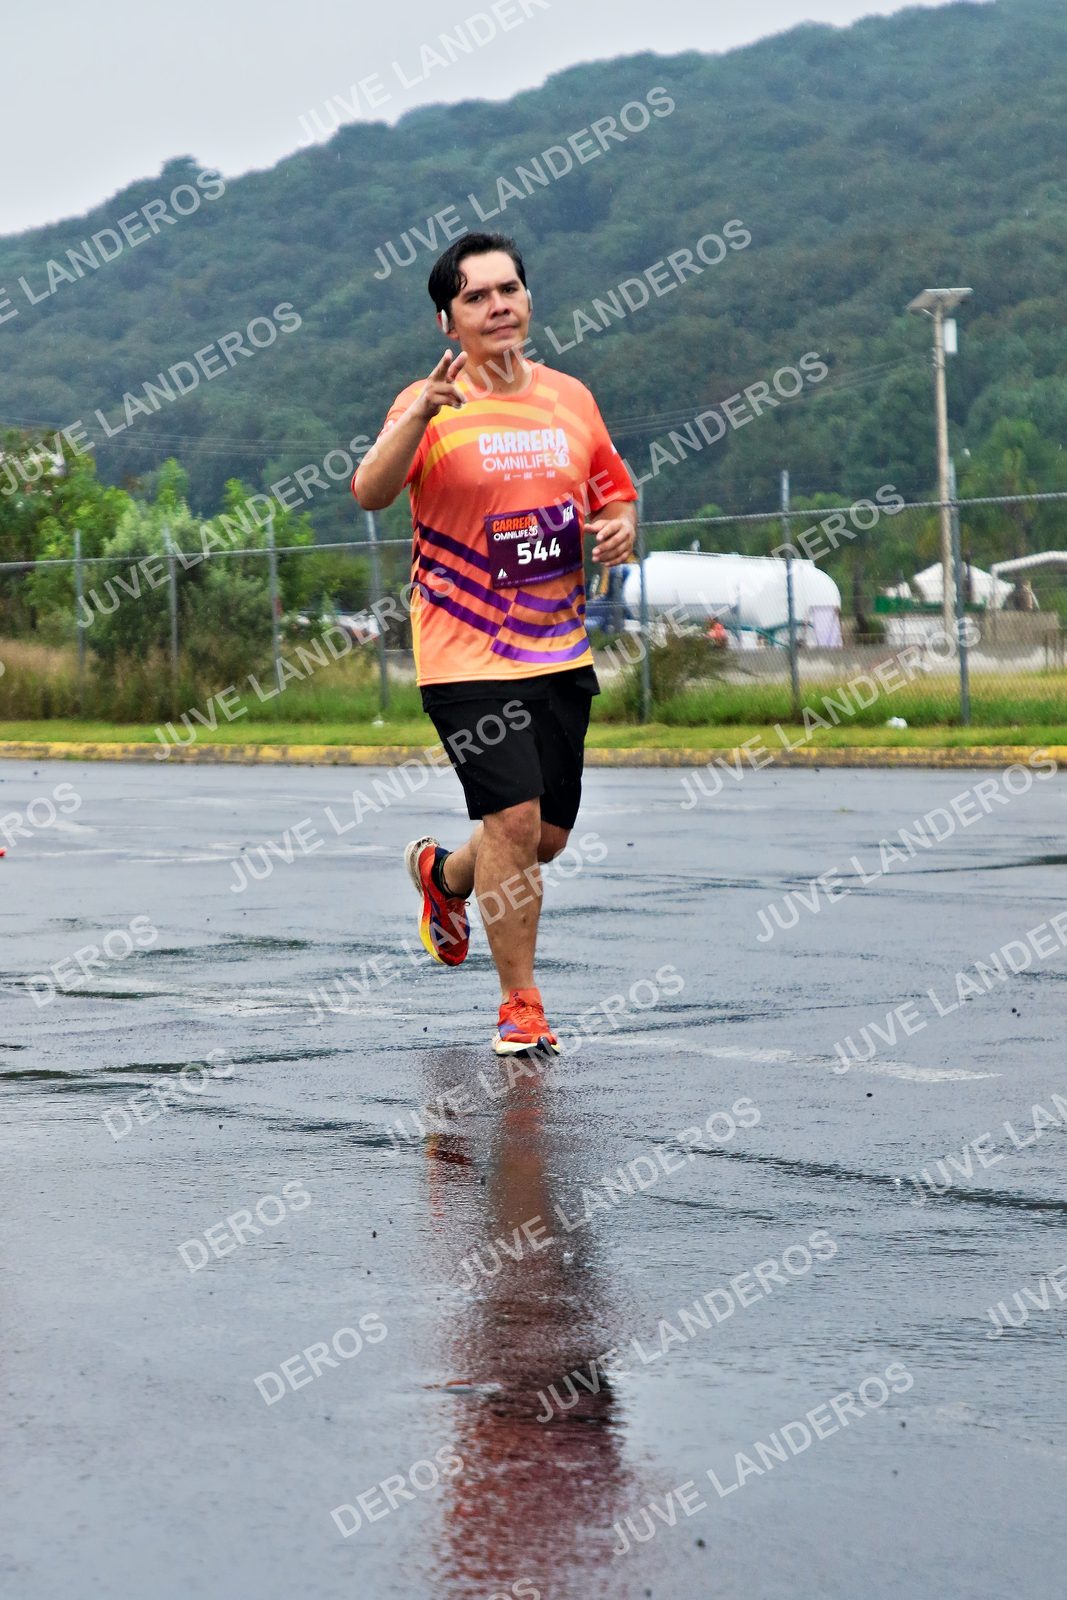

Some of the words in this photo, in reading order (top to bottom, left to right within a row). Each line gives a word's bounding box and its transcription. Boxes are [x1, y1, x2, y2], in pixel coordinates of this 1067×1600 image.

[479, 428, 568, 455] CARRERA
[483, 453, 553, 472] OMNILIFE
[493, 515, 538, 532] CARRERA
[493, 530, 528, 541] OMNILIFE
[517, 538, 561, 565] 544
